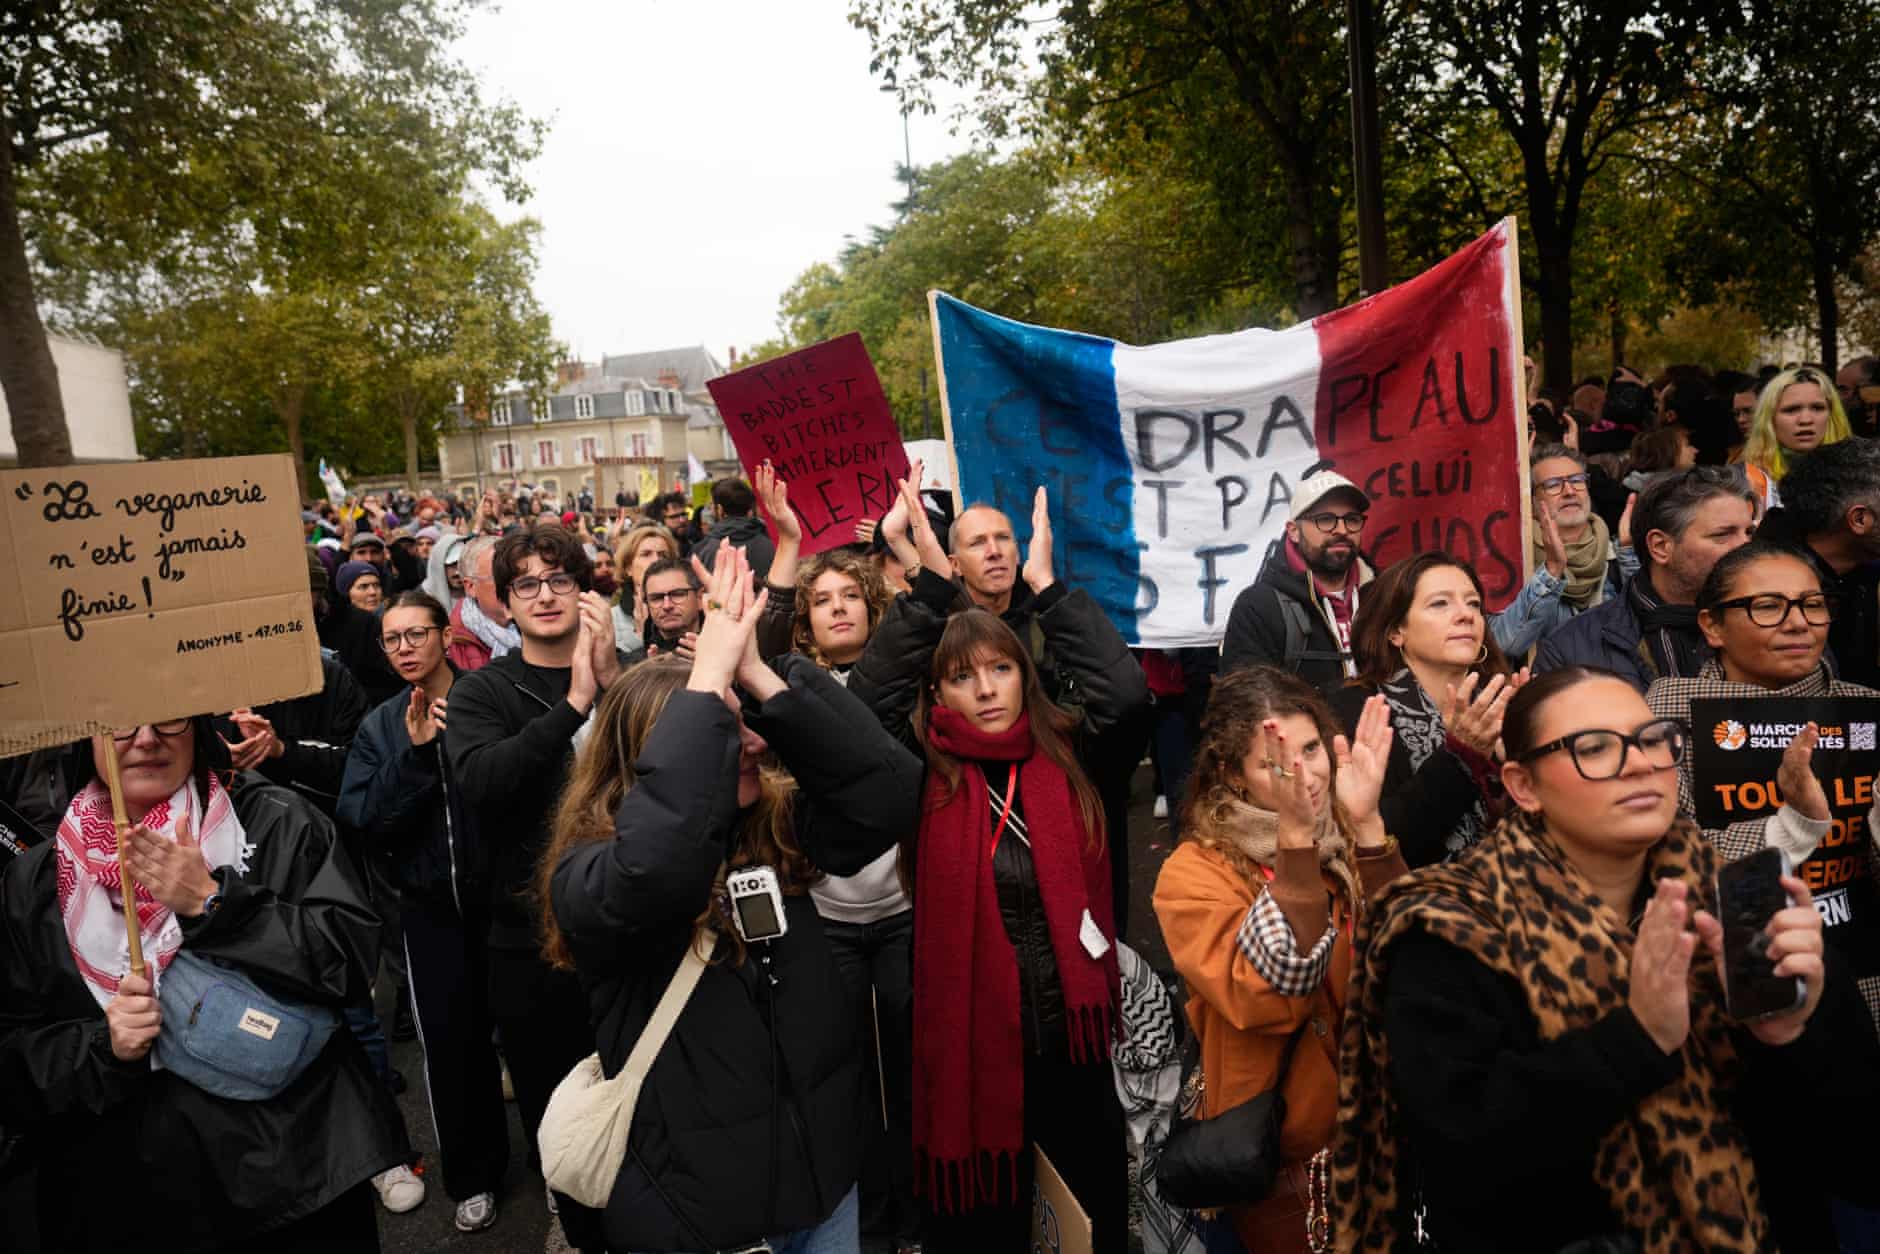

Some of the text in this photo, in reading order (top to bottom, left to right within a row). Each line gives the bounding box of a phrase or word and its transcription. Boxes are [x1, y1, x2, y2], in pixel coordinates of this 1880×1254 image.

[756, 357, 817, 392] THE
[740, 378, 857, 433] BADDEST
[1133, 346, 1500, 474] DRAPEAU
[762, 412, 866, 454] BITCHES
[774, 441, 889, 481] MMERDENT
[115, 480, 267, 532] veganerie
[787, 479, 854, 538] LE
[154, 528, 247, 579] jamais
[176, 631, 243, 654] ANONYME
[1750, 723, 1843, 736] MARCH DES
